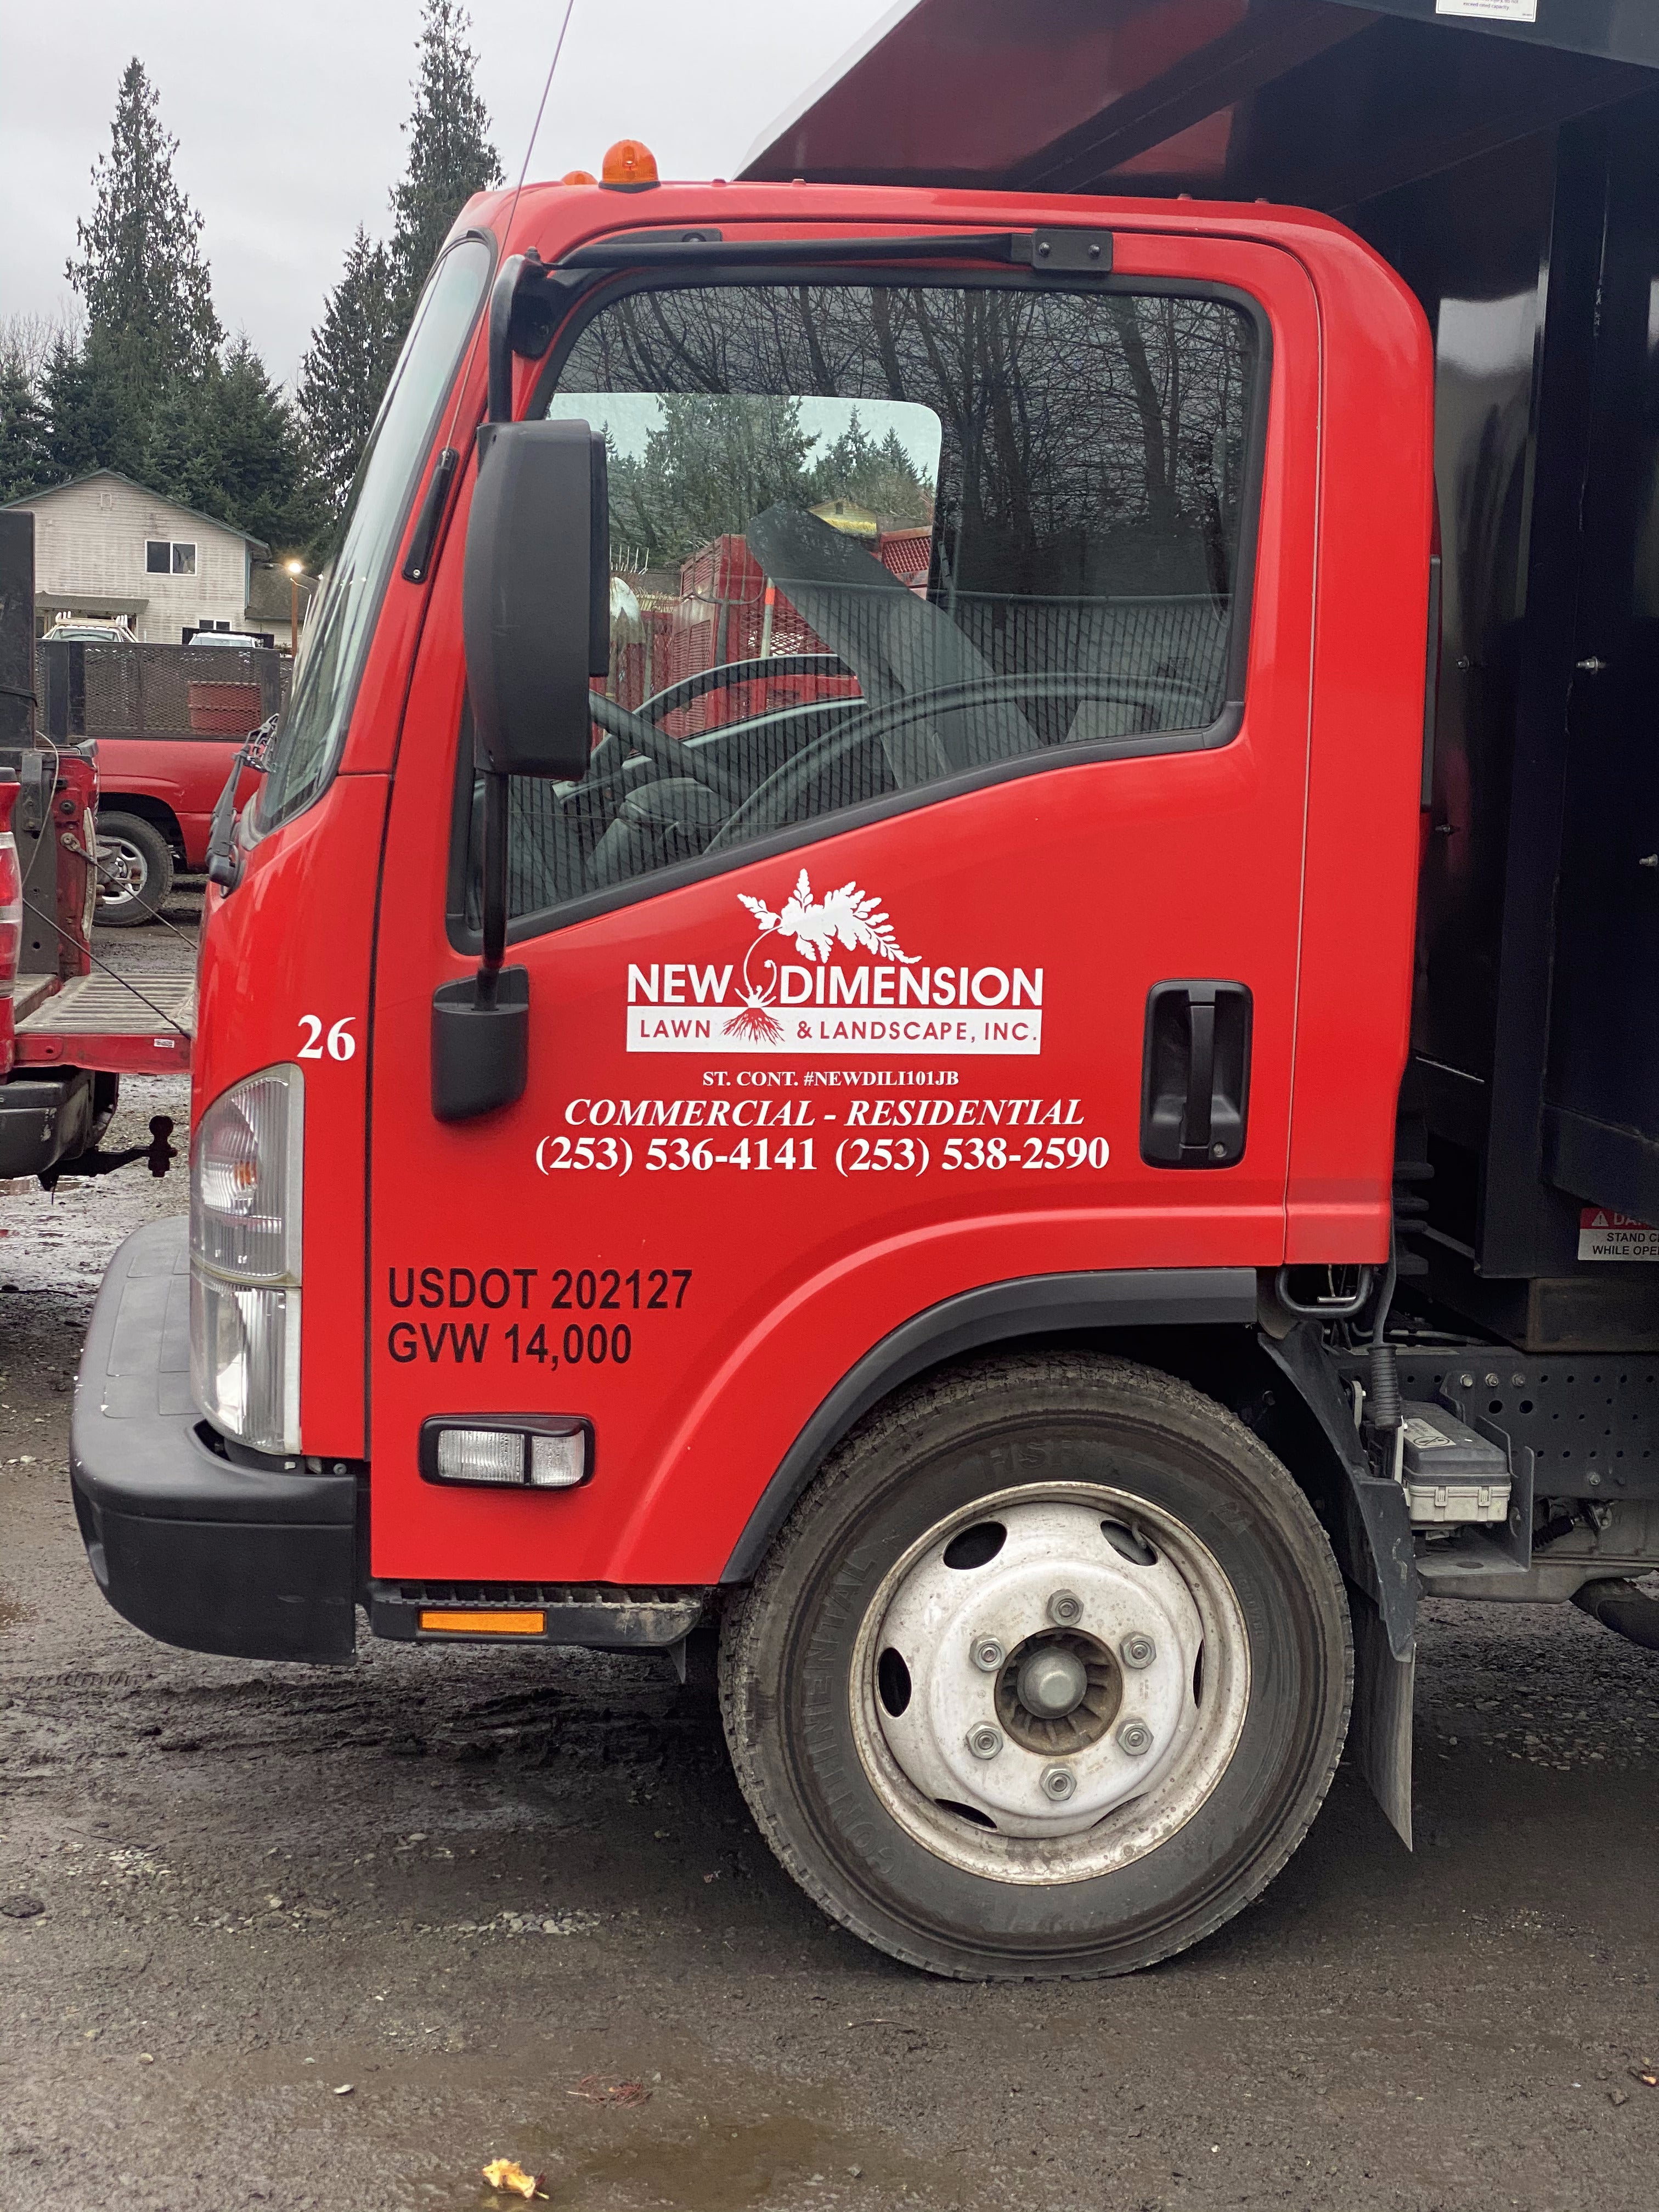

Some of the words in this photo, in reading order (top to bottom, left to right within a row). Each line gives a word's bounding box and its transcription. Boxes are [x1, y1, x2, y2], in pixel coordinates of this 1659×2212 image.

[627, 964, 734, 1003] NEW
[780, 965, 1043, 1006] DIMENSION
[297, 1014, 356, 1061] 26
[641, 1020, 710, 1037] LAWN
[797, 1021, 812, 1039] &
[820, 1022, 975, 1043] LANDSCAPE,
[985, 1023, 1037, 1041] INC.
[703, 1071, 731, 1086] ST.
[736, 1071, 799, 1086] CONT.
[804, 1071, 959, 1086] #NEWDILI101JB
[565, 1099, 815, 1126] COMMERCIAL
[843, 1099, 1085, 1126] RESIDENTIAL
[536, 1136, 633, 1177] (253)
[646, 1138, 817, 1171] 536-4141
[836, 1138, 929, 1177] (253)
[941, 1137, 1110, 1170] 538-2590
[1593, 1245, 1629, 1255] WHILE
[1633, 1246, 1659, 1255] OPE
[1607, 1232, 1645, 1242] STAND
[1649, 1233, 1659, 1242] C
[389, 1267, 538, 1309] USDOT
[551, 1269, 692, 1310] 202127
[388, 1322, 489, 1363] GVW
[505, 1323, 631, 1371] 14,000
[803, 1555, 904, 1885] CONTINENTAL
